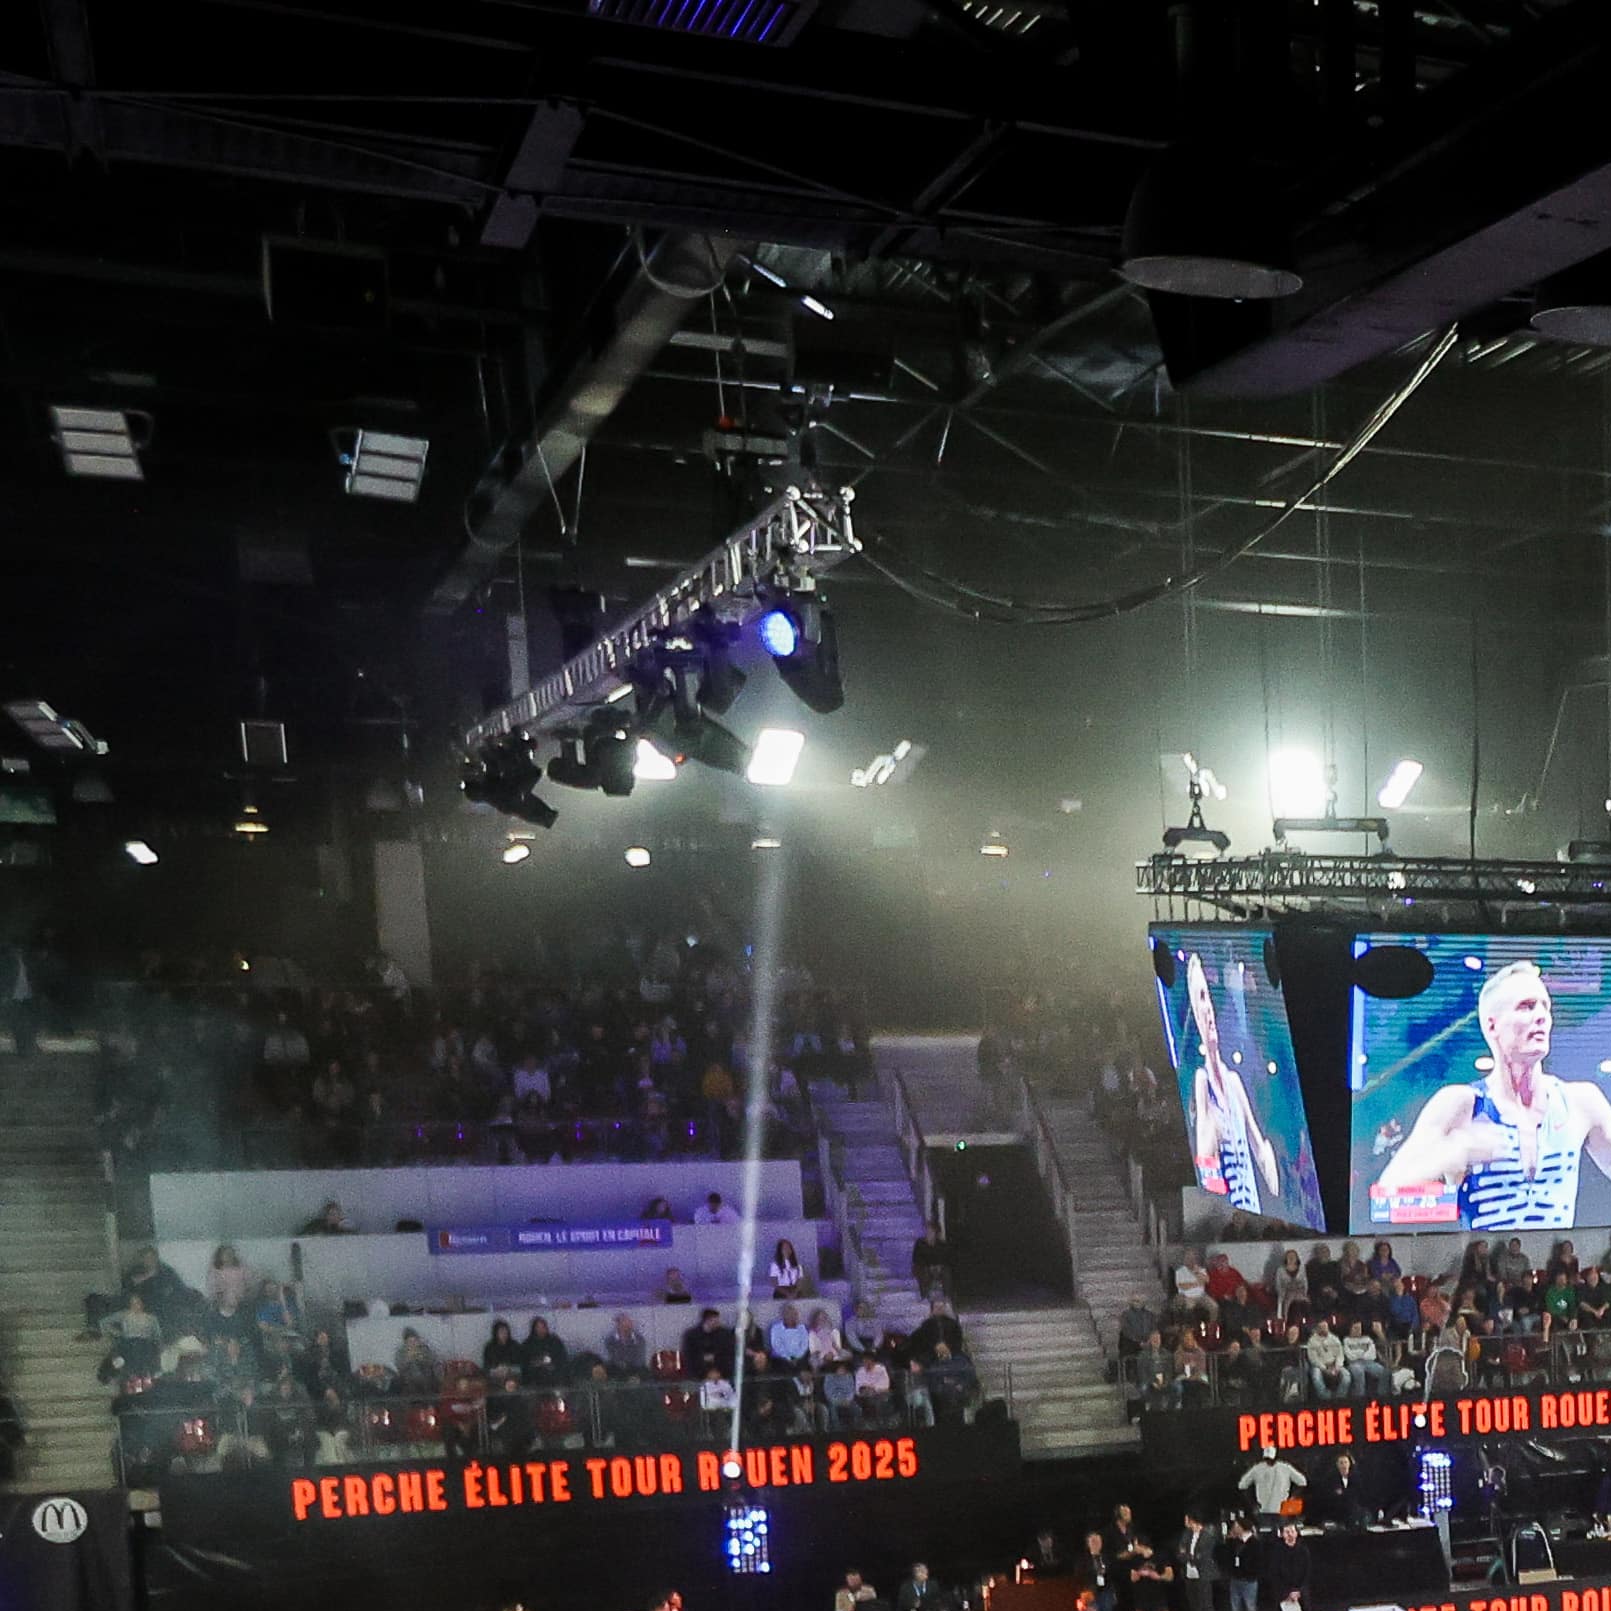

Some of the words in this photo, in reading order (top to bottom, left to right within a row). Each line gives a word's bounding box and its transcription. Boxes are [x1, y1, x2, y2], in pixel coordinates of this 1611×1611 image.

[1238, 1408, 1353, 1450] PERCHE
[1457, 1395, 1530, 1436] TOUR
[291, 1468, 449, 1521] PERCHE
[463, 1459, 572, 1509] ÉLITE
[585, 1452, 684, 1500] TOUR
[829, 1438, 919, 1483] 2025
